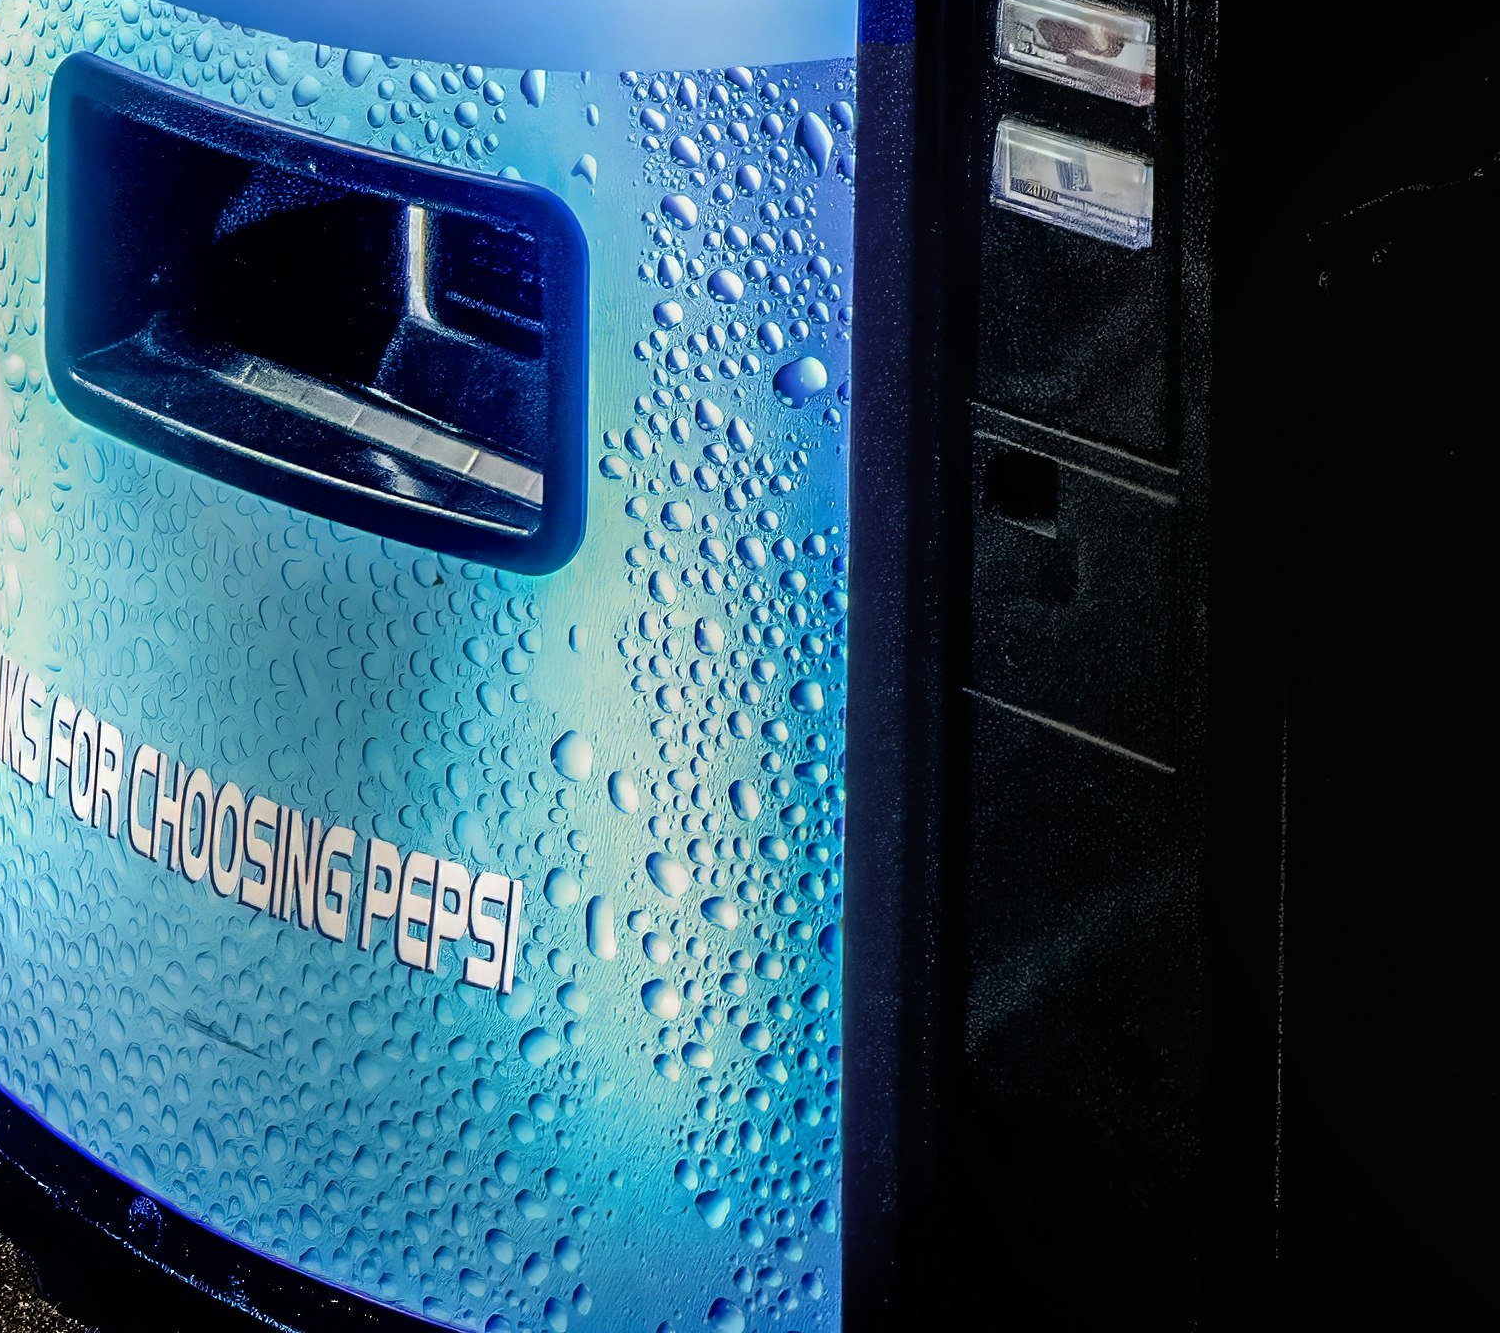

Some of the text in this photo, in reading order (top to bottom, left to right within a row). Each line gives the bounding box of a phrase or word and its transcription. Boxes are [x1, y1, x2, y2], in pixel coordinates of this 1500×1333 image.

[46, 693, 124, 839] FOR
[126, 743, 356, 943] CHOOSING
[357, 836, 524, 995] PEPSI
